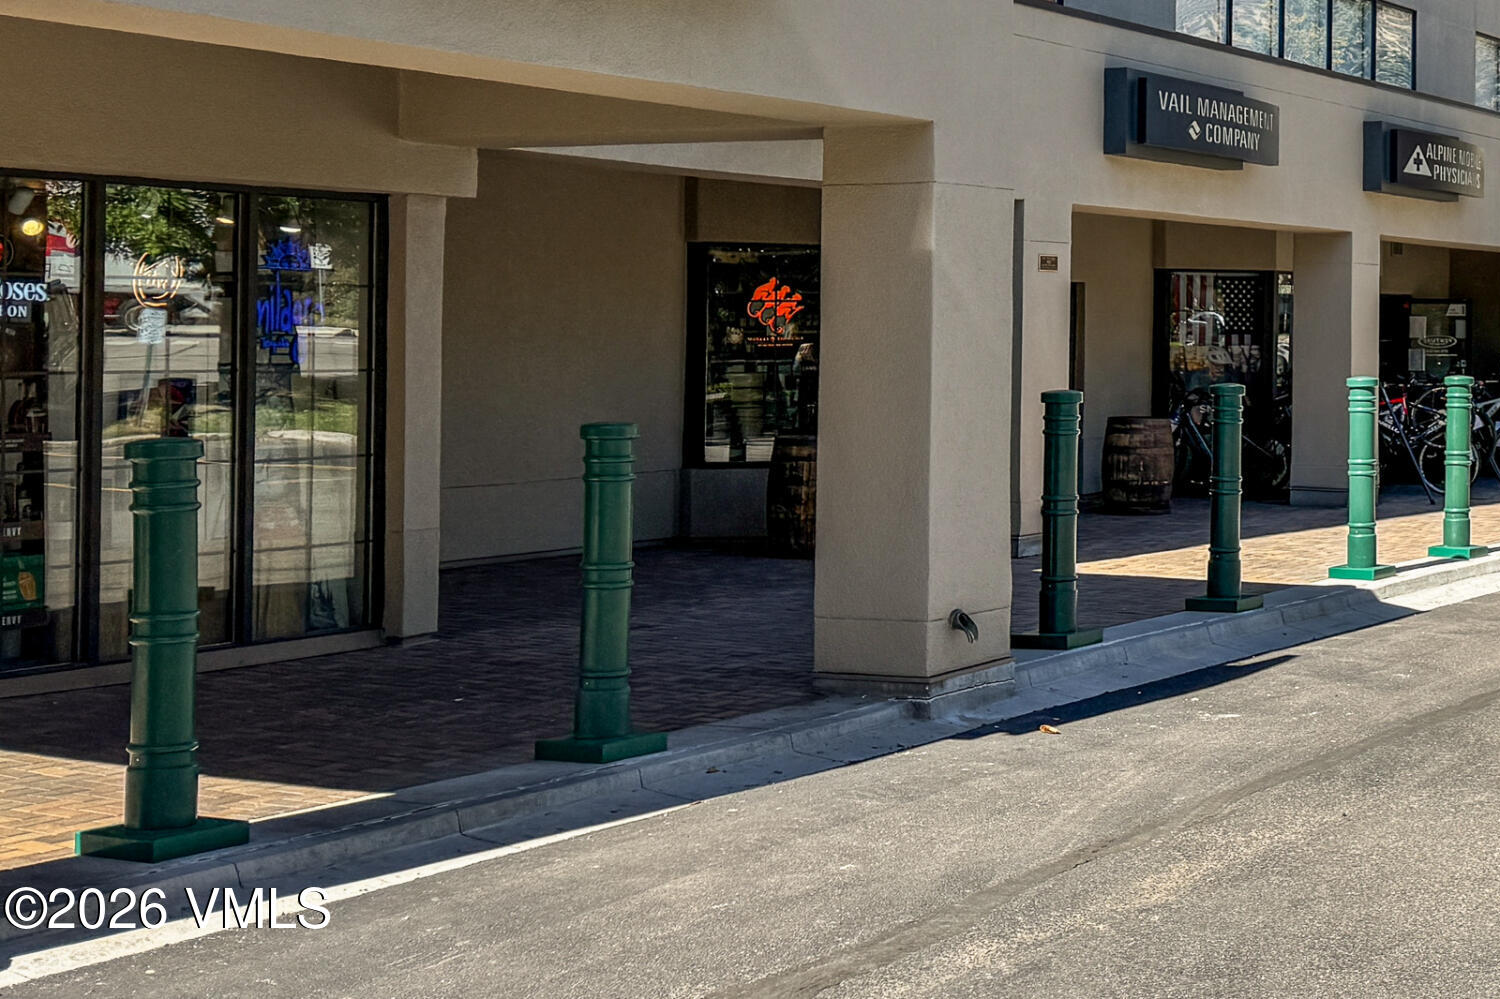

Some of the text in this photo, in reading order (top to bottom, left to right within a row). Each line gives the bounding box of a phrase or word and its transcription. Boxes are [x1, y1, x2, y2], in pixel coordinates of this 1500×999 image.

[1158, 90, 1274, 132] VAIL MANAGEMENT
[1205, 123, 1260, 152] COMPANY
[1426, 142, 1482, 171] ALPINE MOBLE
[1433, 164, 1481, 189] PHYSICIAS
